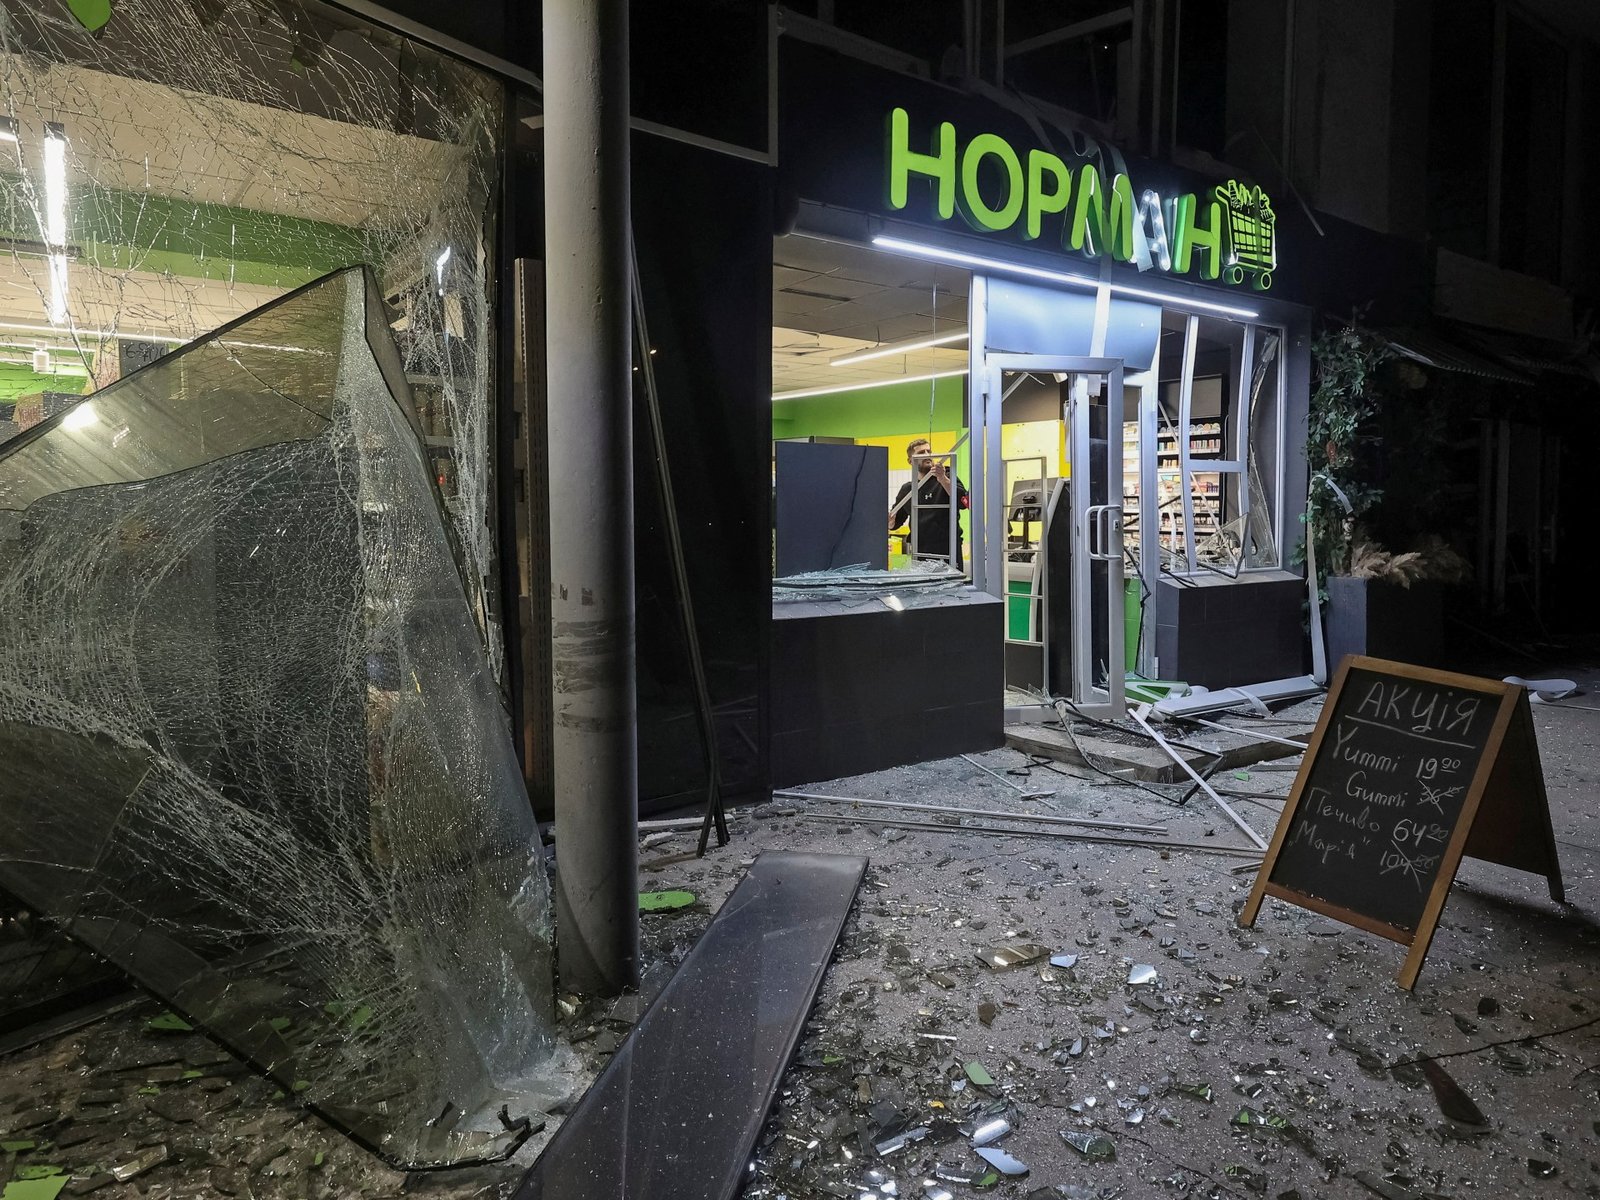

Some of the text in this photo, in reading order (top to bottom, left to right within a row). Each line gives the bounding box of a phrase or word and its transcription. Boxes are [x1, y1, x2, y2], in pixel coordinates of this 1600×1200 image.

[888, 106, 1222, 281] НОРМАН
[1332, 723, 1401, 773] Yummi
[1304, 786, 1381, 833] Печиво
[1345, 770, 1410, 808] Gummi
